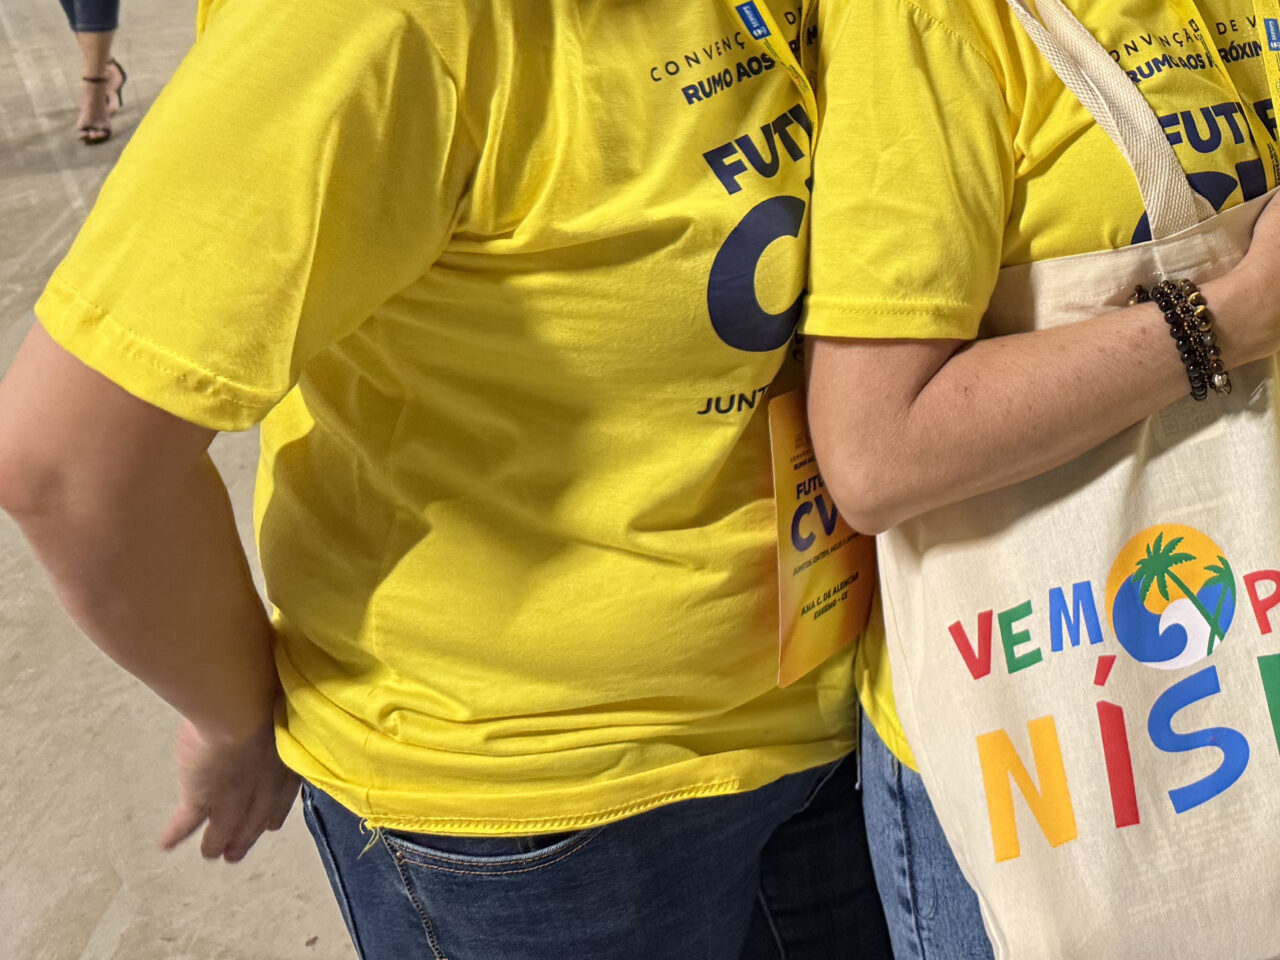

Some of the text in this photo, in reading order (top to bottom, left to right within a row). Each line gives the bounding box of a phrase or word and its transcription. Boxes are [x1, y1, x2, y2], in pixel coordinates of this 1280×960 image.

[1216, 19, 1237, 36] DE
[682, 52, 776, 105] RUMO AOS
[948, 580, 1104, 680] VEM
